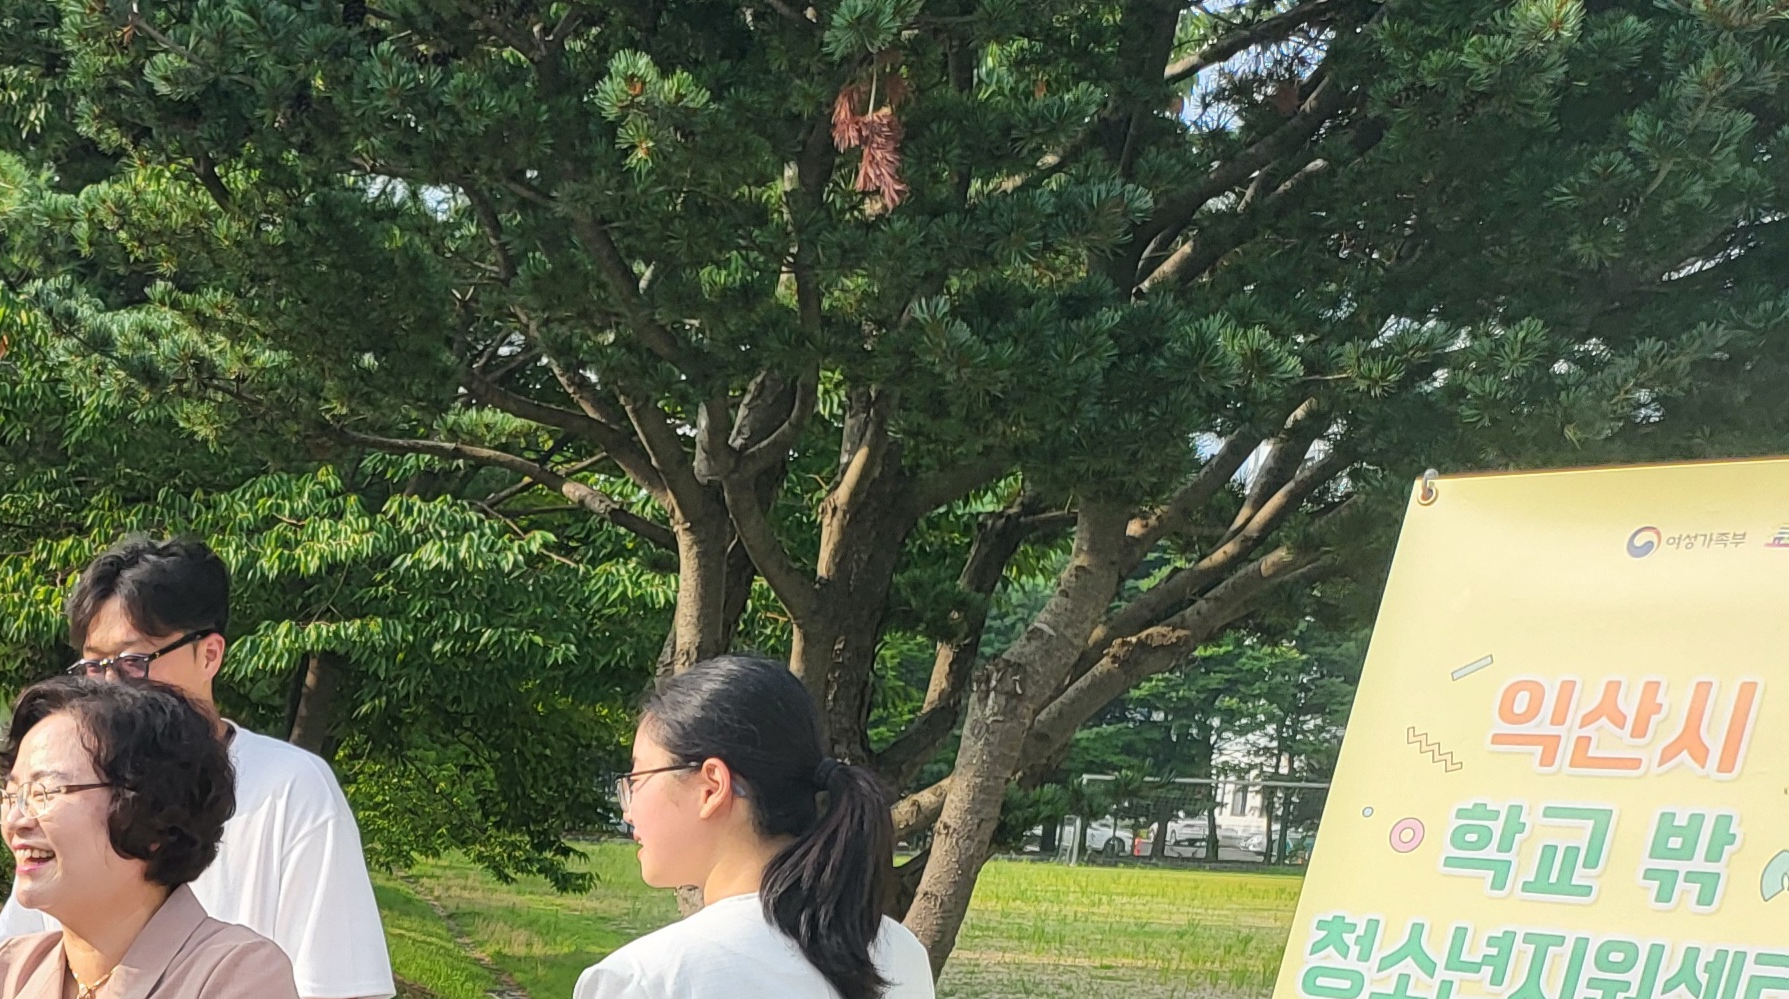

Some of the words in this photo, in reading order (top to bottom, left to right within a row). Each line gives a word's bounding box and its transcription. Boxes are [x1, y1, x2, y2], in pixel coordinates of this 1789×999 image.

[1665, 531, 1747, 551] 여성가족부
[1490, 679, 1759, 774] 익산시
[1442, 803, 1614, 897] 학교
[1640, 811, 1737, 907] 밖
